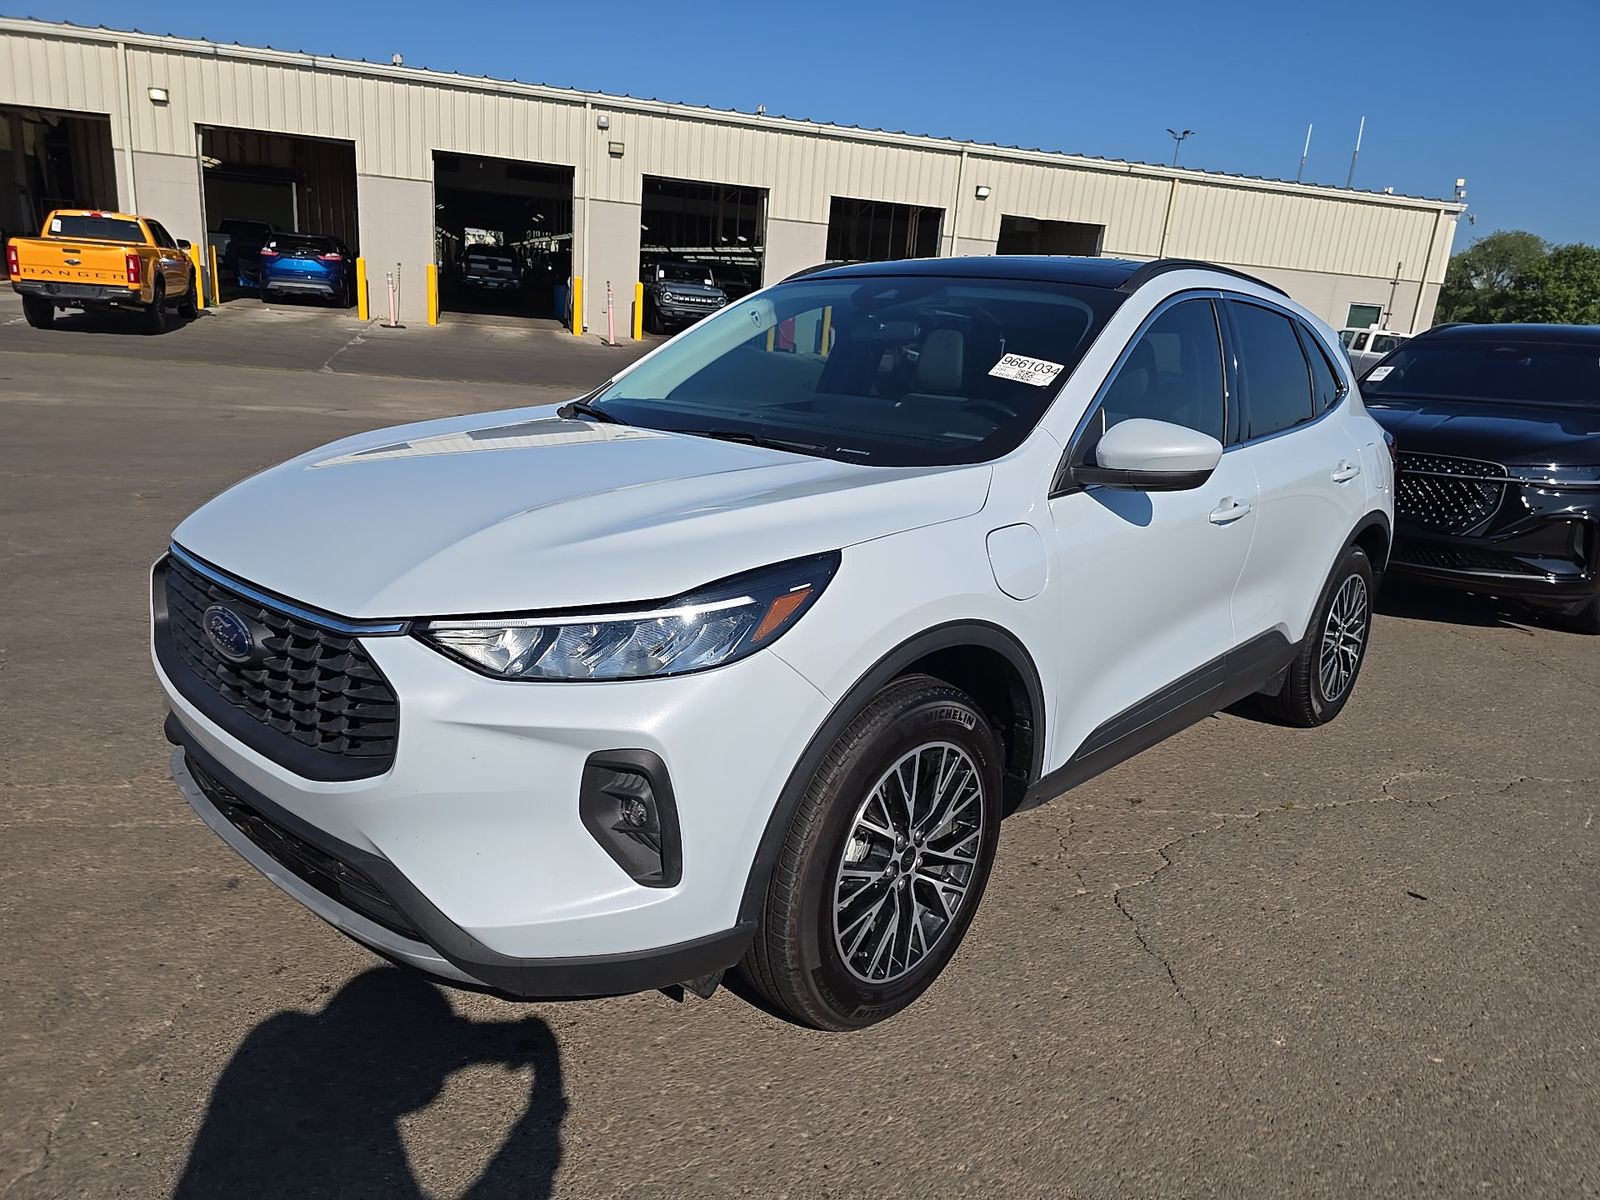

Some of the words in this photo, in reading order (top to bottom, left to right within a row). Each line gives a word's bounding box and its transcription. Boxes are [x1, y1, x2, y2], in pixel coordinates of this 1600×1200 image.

[23, 268, 126, 280] RANGER
[1001, 356, 1061, 375] 9661034
[927, 708, 975, 726] MICHELIN
